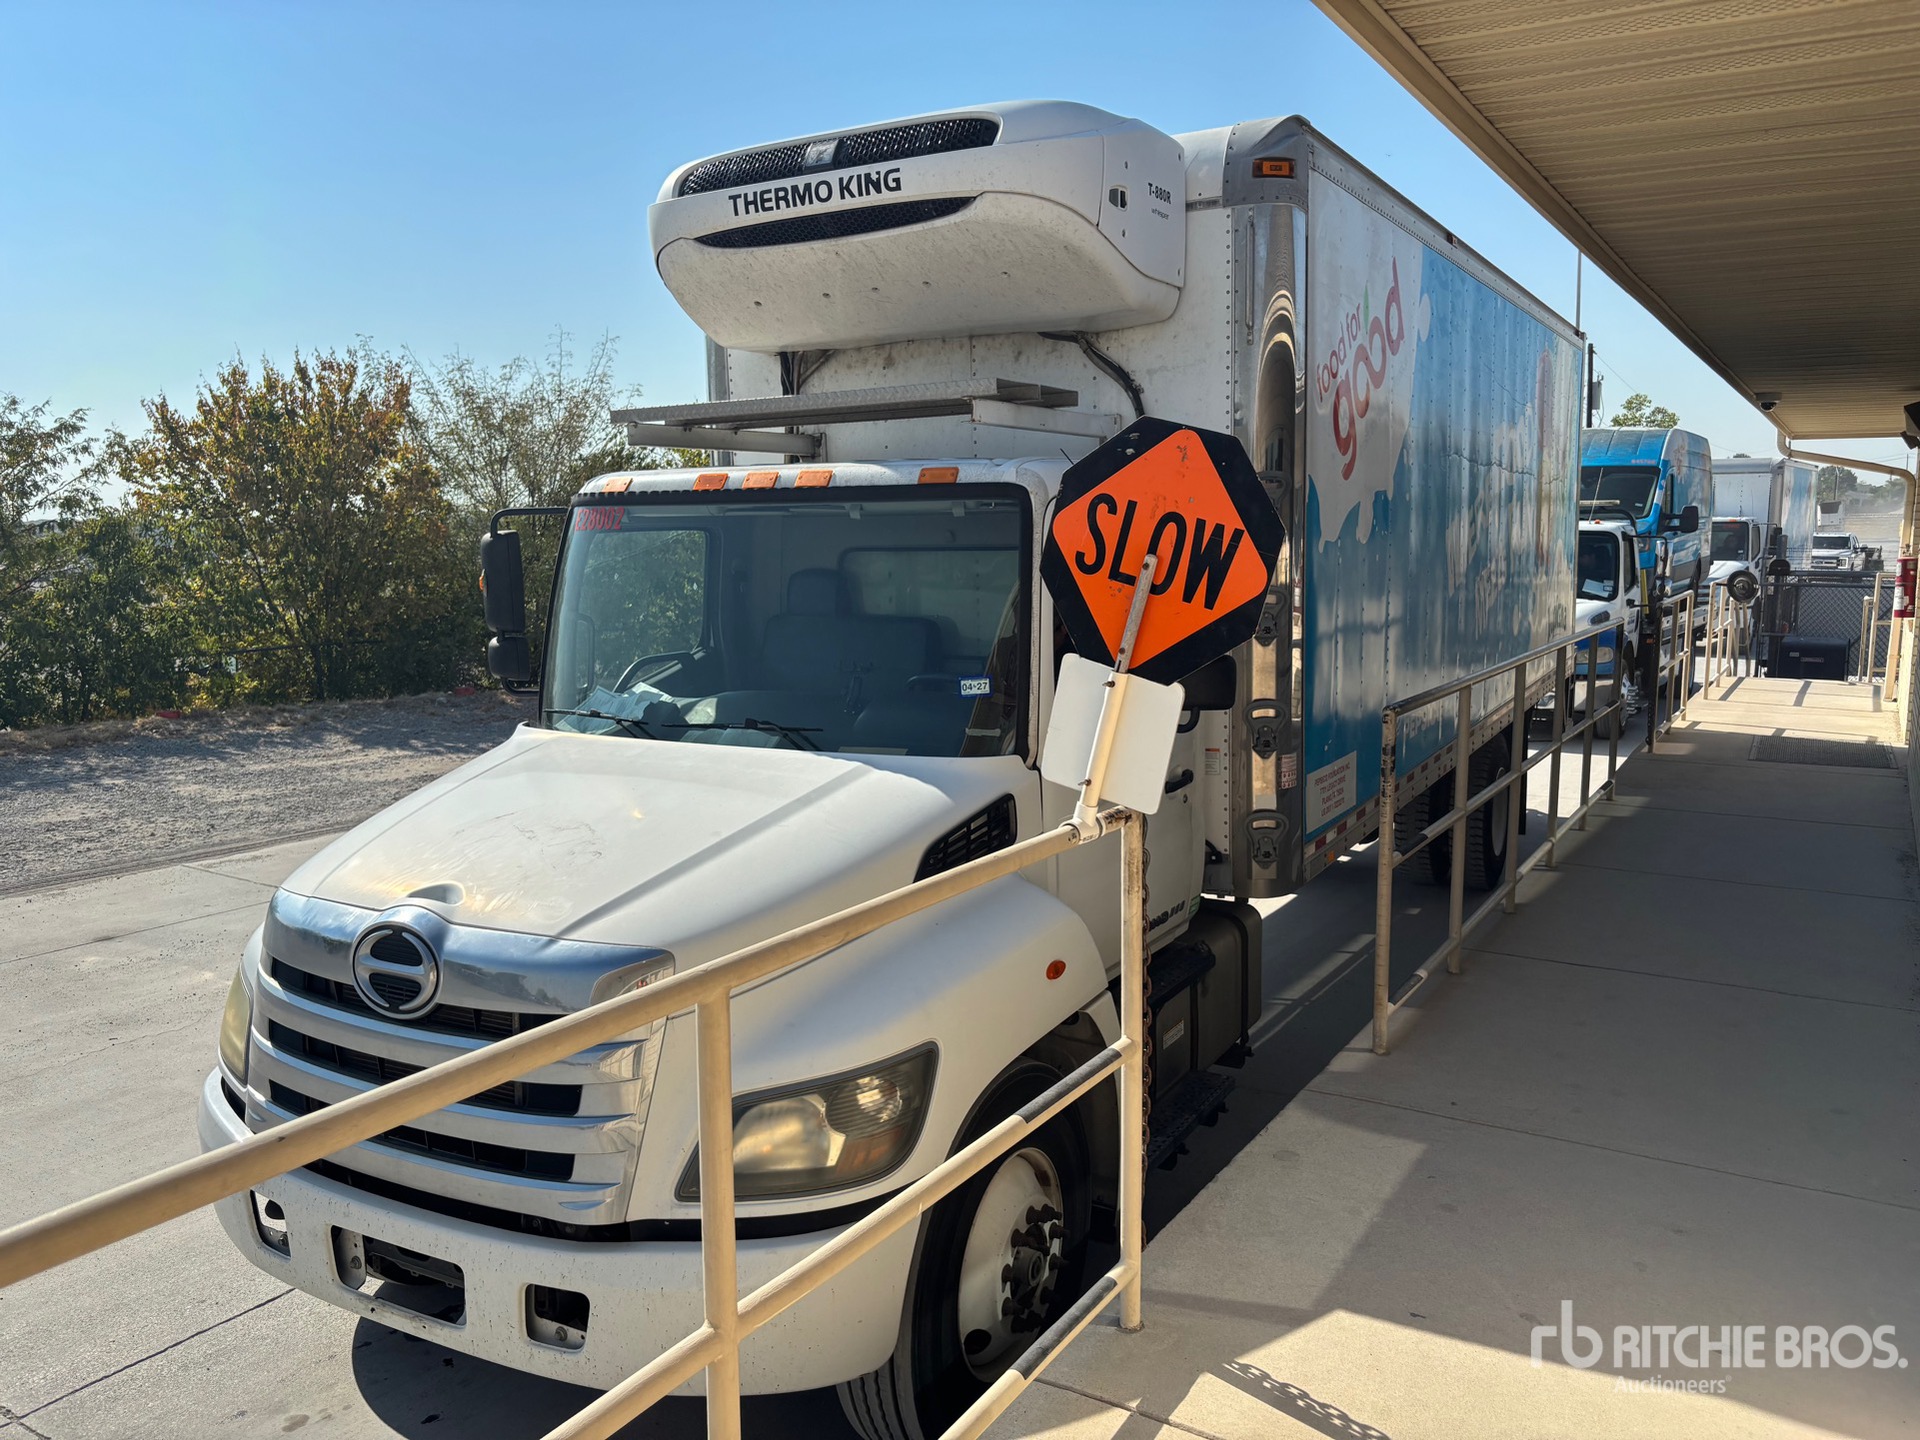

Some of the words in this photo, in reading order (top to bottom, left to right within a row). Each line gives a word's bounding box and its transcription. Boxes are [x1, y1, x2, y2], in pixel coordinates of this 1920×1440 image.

[728, 180, 833, 216] THERMO
[838, 168, 902, 200] KING
[1147, 182, 1172, 204] T-880R
[1316, 321, 1347, 403] food
[1346, 303, 1361, 350] for
[1332, 256, 1405, 481] good
[1075, 492, 1245, 611] SLOW
